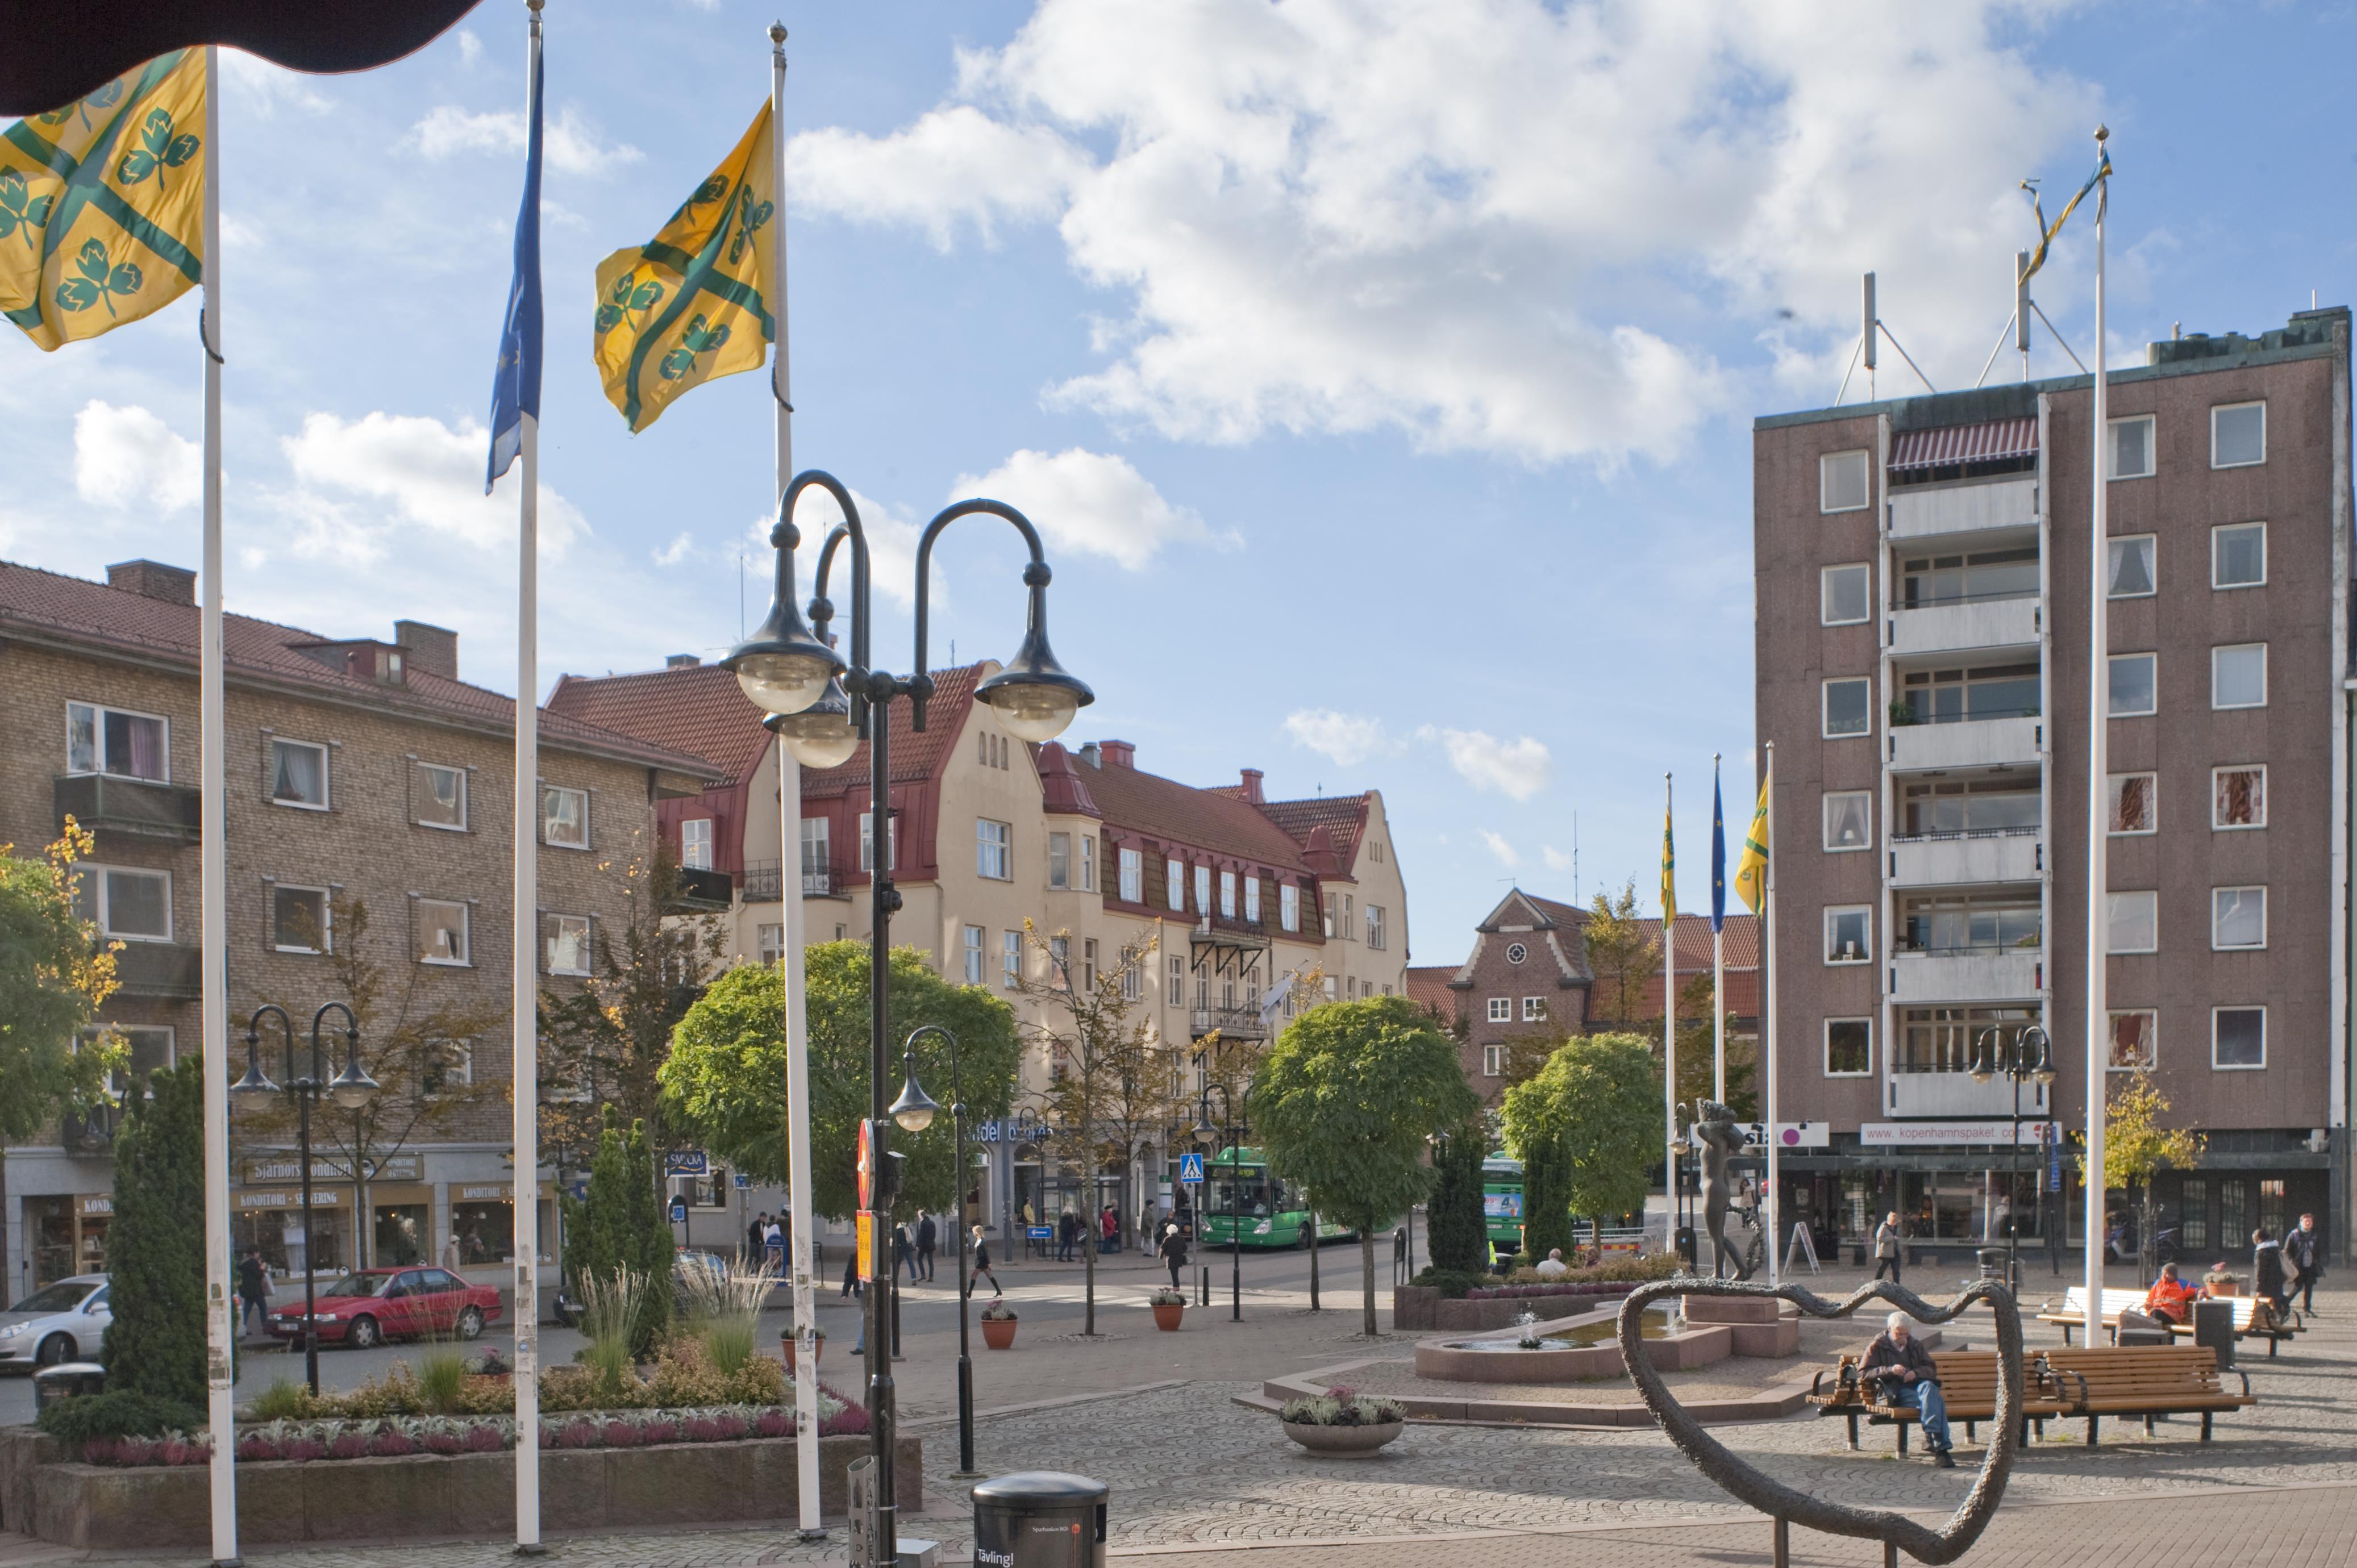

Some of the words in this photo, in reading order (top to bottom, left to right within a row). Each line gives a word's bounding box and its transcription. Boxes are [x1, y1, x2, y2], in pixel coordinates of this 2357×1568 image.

[1867, 1129, 1894, 1138] www.
[1900, 1127, 1997, 1140] kopenhamnspaket.
[2002, 1128, 2025, 1137] com
[310, 1161, 352, 1178] onditori
[240, 1194, 286, 1207] KONDITORI
[295, 1192, 337, 1205] SEVERING
[463, 1187, 500, 1199] KONDITORI
[978, 1548, 1014, 1568] Tävling!
